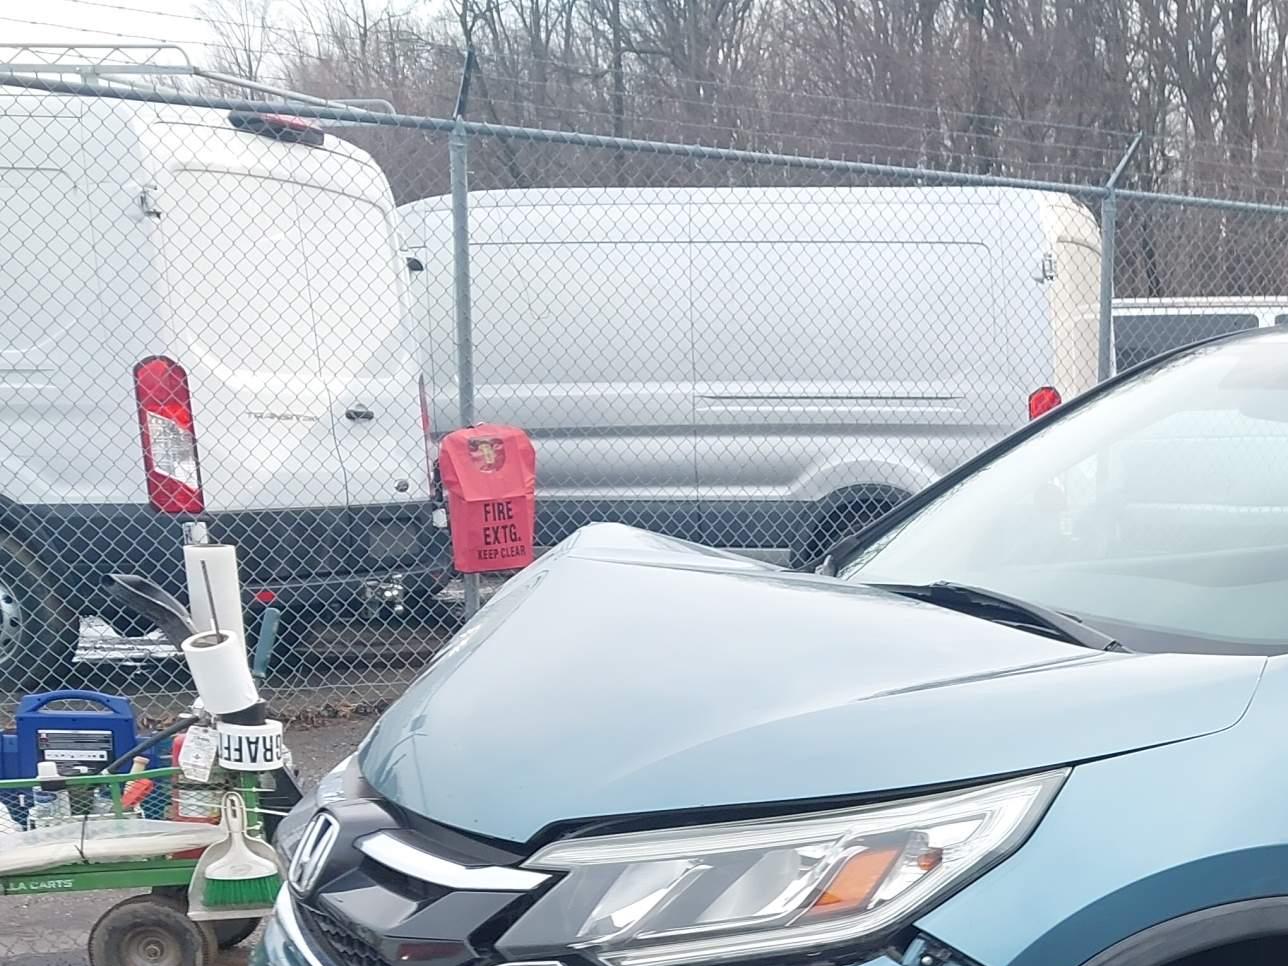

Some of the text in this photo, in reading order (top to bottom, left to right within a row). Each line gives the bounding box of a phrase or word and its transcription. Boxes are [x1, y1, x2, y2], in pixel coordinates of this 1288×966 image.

[483, 501, 514, 522] FIRE
[483, 523, 522, 546] EXTG.
[477, 544, 527, 560] KEEP CLEAR
[30, 878, 73, 890] CARTS
